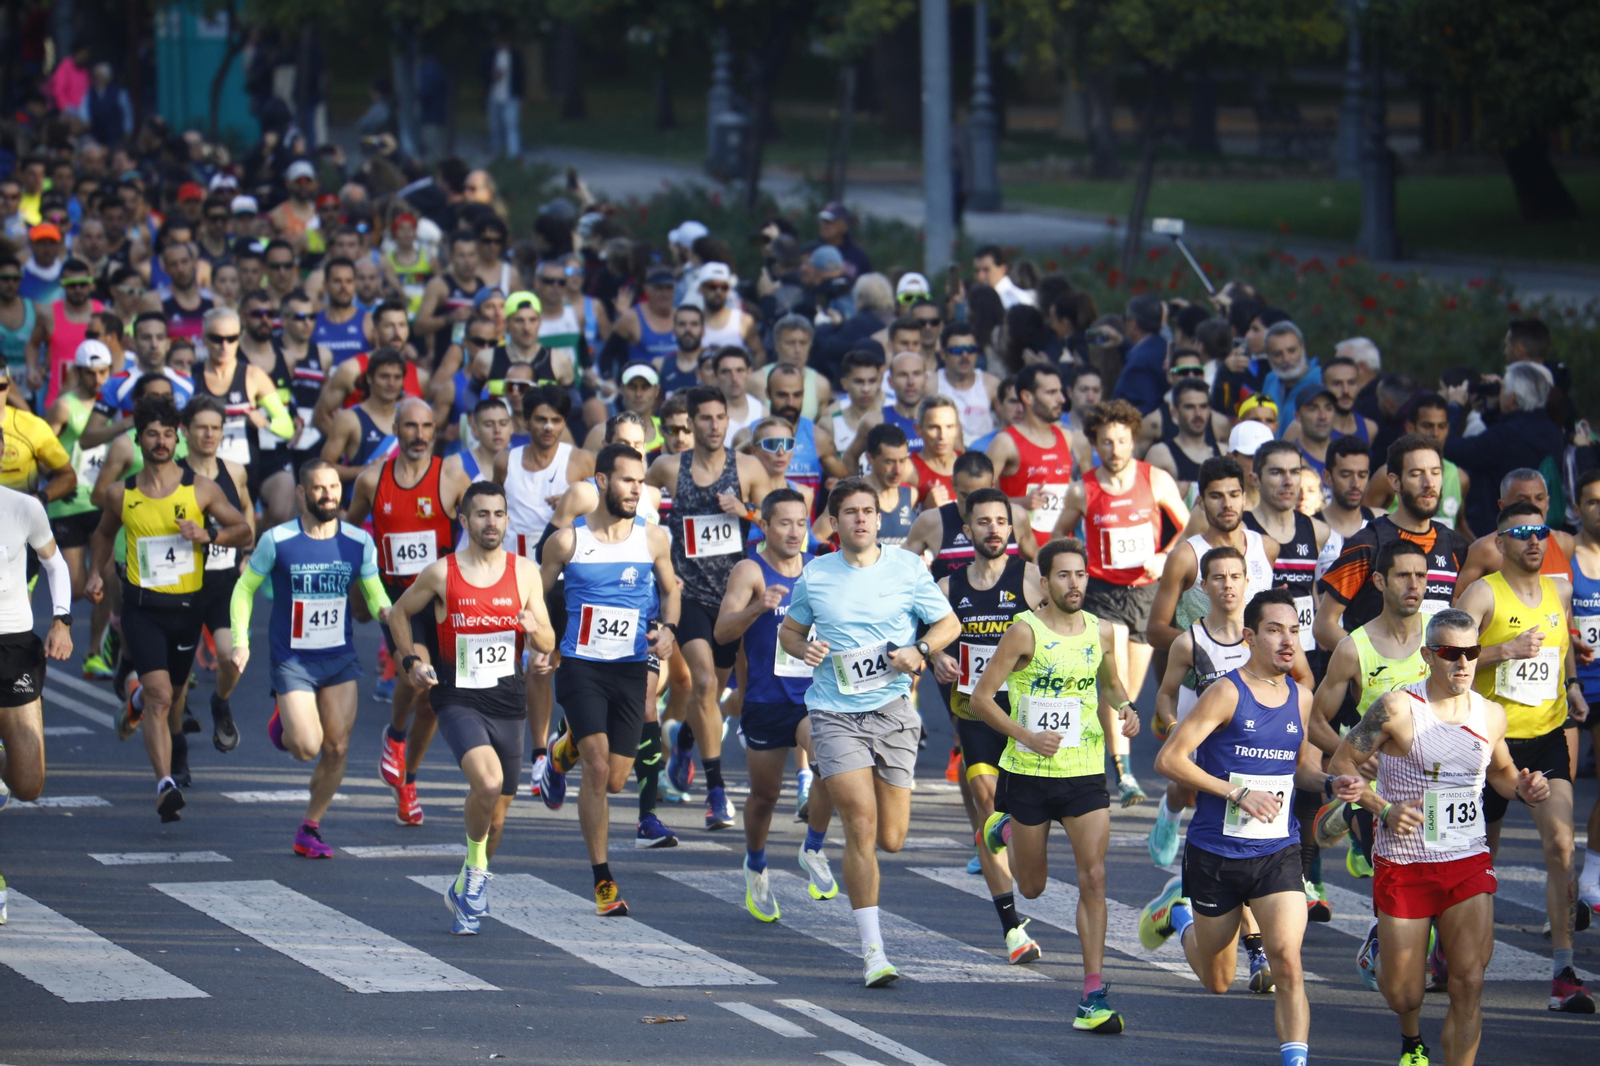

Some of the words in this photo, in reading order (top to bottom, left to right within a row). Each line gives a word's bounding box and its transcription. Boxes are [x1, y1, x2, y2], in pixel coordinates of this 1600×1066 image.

[701, 524, 731, 541] 410
[165, 547, 176, 563] 4
[397, 543, 428, 560] 463
[302, 563, 352, 572] ANIVERSARIO
[309, 609, 338, 626] 413
[597, 618, 630, 637] 342
[1587, 627, 1600, 644] 3
[475, 645, 507, 664] 132
[848, 648, 872, 659] IMDECO
[851, 654, 888, 679] 124
[974, 656, 992, 674] 2
[1516, 662, 1549, 681] 429
[1037, 711, 1071, 731] 434
[1445, 801, 1477, 824] 133
